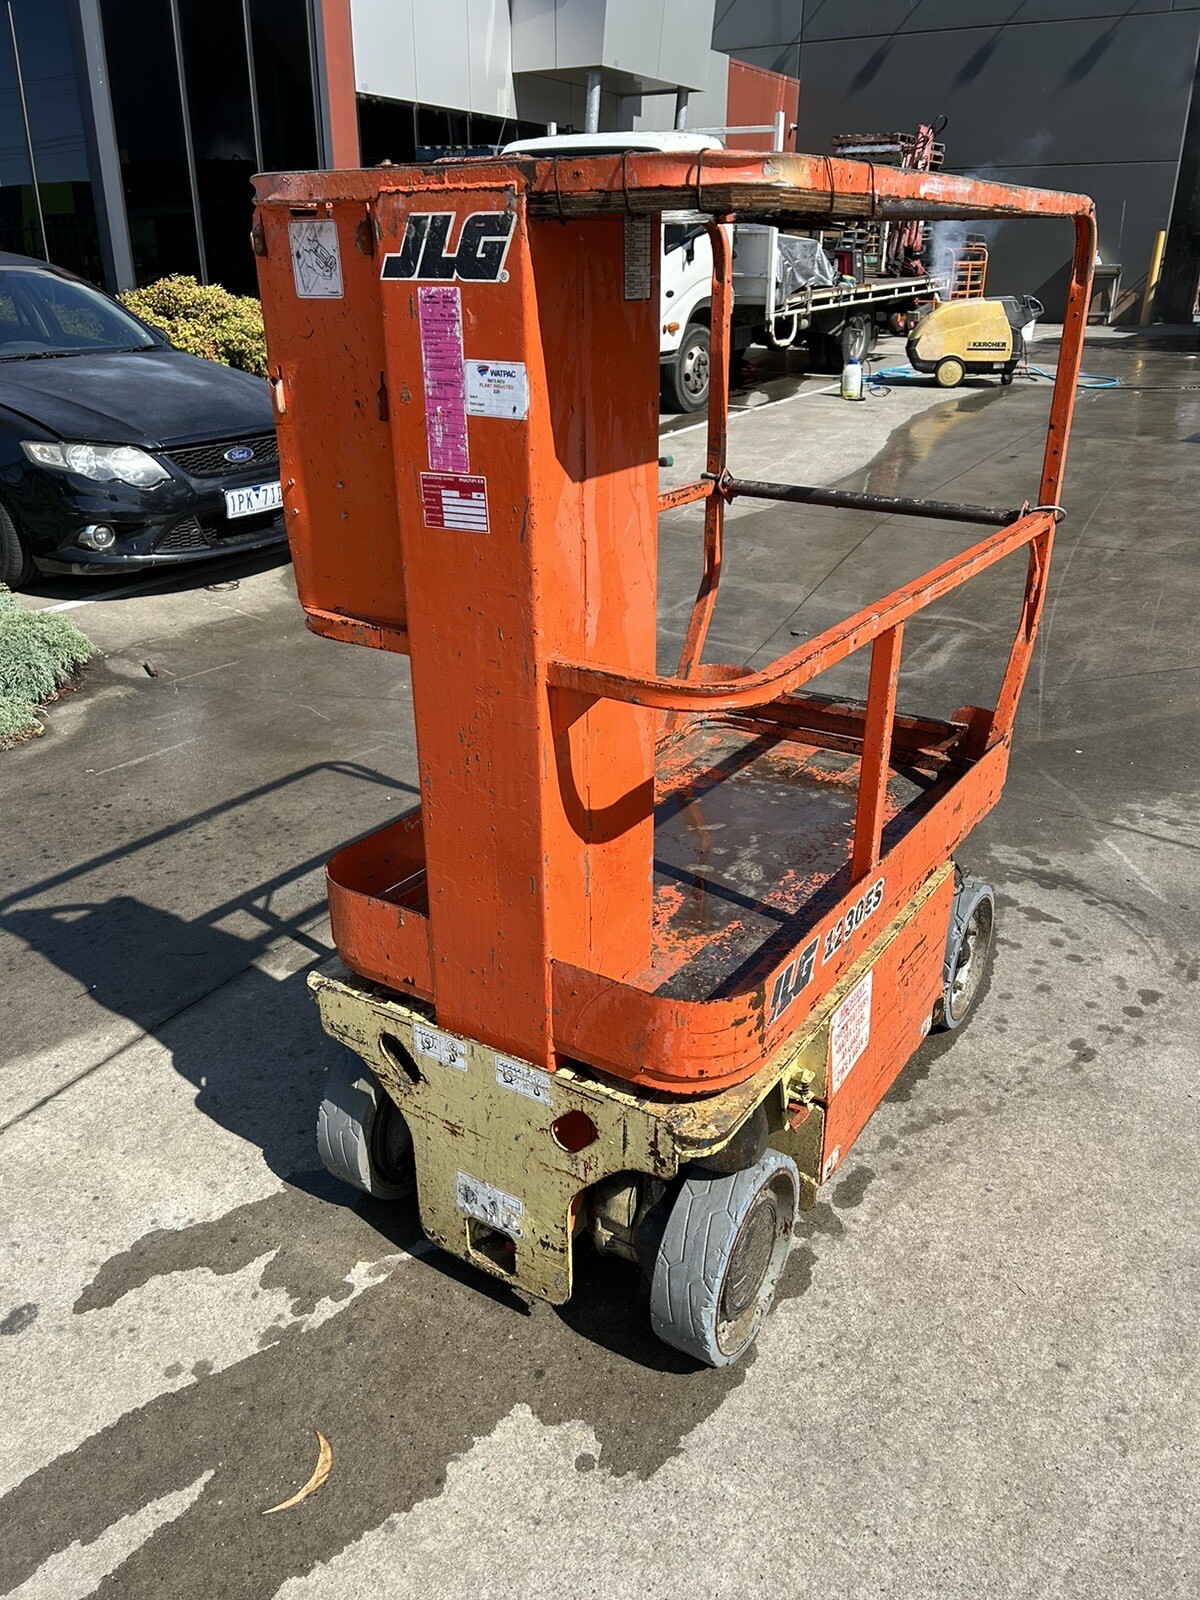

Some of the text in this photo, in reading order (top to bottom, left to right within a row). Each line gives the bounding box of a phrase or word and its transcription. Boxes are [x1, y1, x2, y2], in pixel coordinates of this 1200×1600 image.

[380, 211, 517, 282] JLG
[490, 369, 516, 378] WATPAC
[232, 449, 248, 460] Ford
[230, 491, 253, 512] 1PK
[765, 934, 821, 1027] JLG
